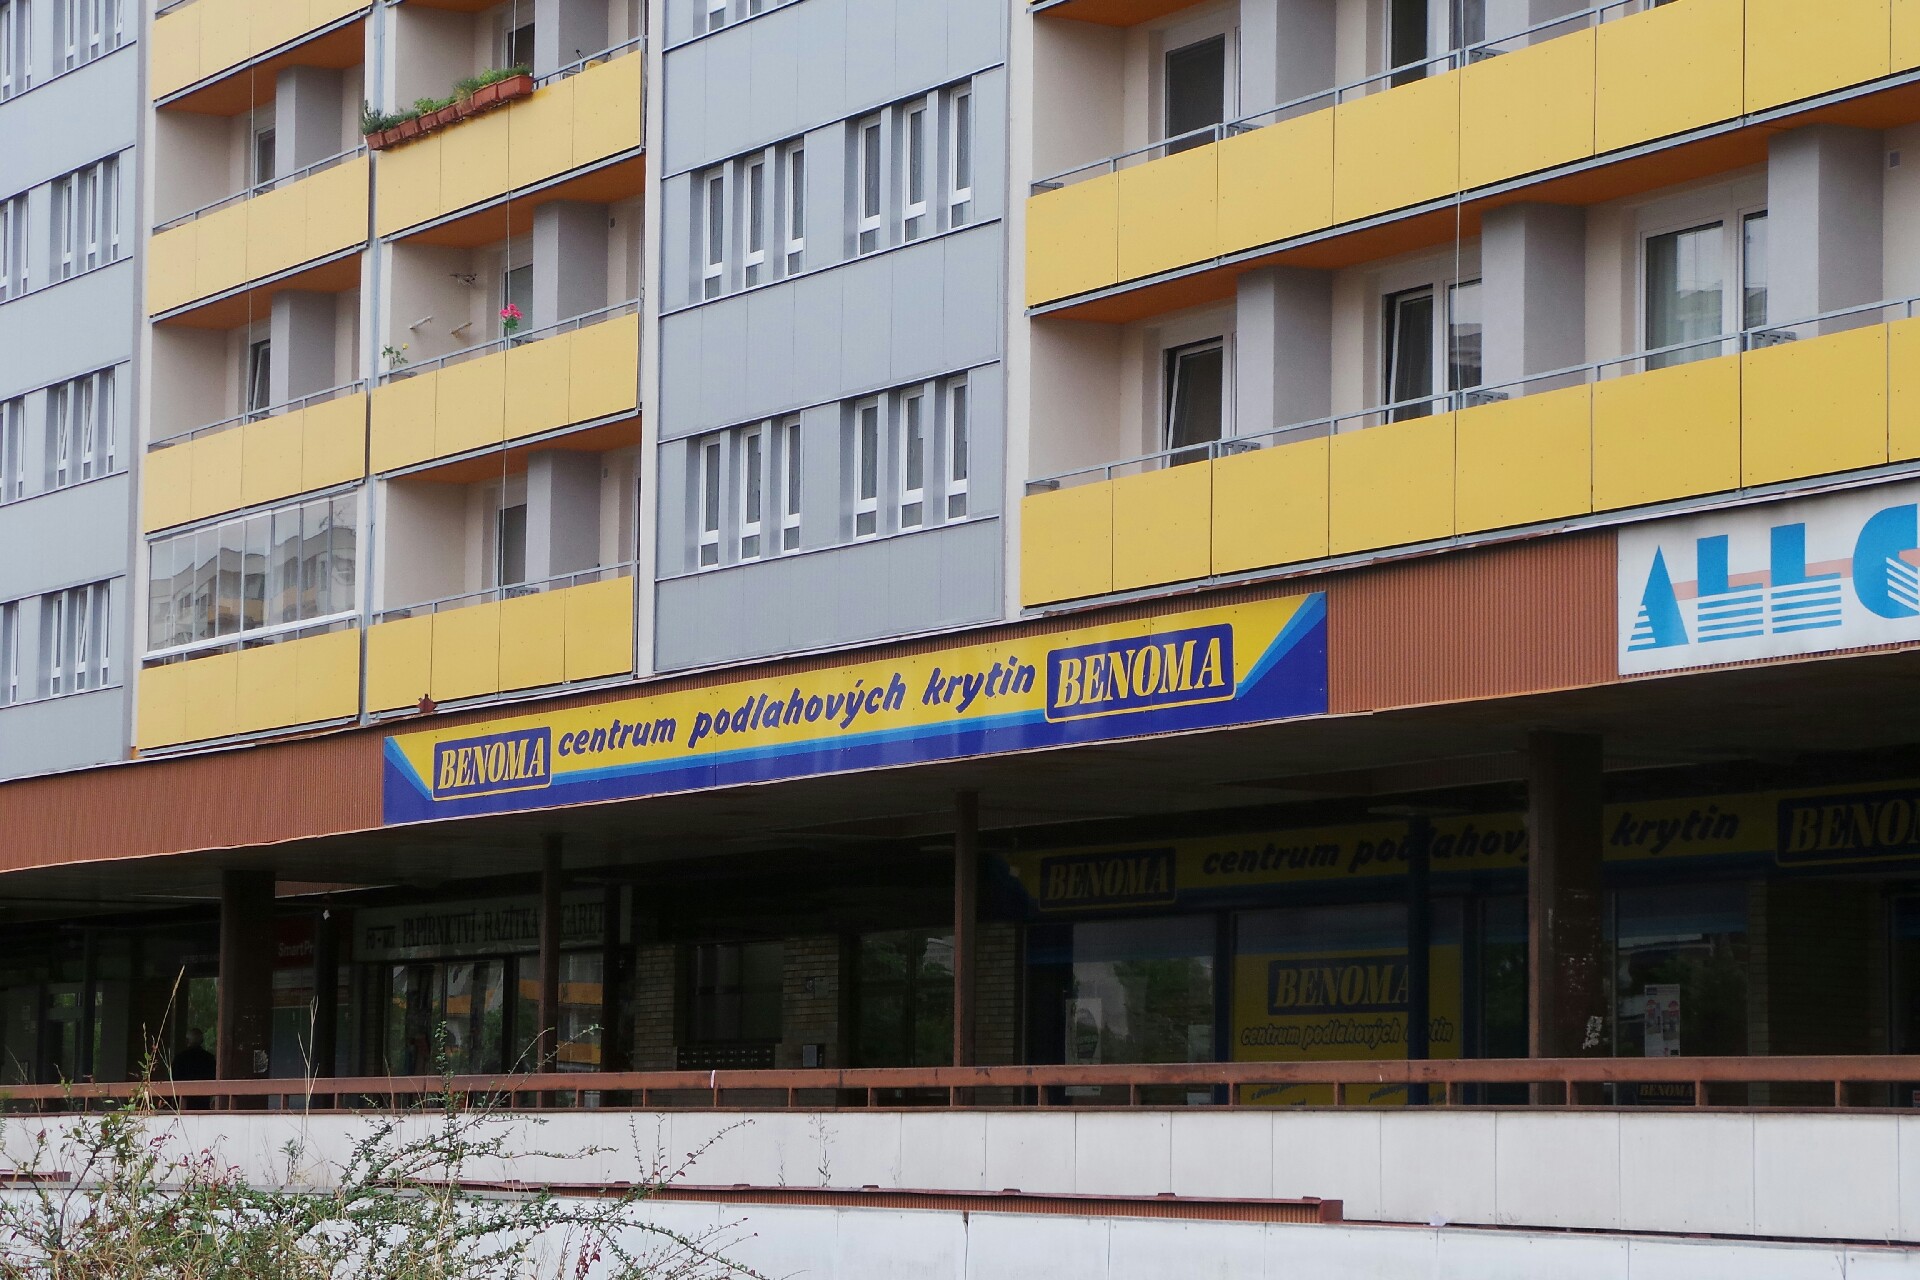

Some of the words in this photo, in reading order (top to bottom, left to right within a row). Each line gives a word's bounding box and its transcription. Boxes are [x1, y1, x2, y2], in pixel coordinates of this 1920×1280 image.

[438, 737, 546, 790] BENOMA
[557, 714, 677, 757] centrum
[687, 671, 906, 749] podlahových
[921, 655, 1036, 713] krytin
[1053, 637, 1226, 708] BENOMA
[1046, 857, 1169, 900] BENOMA
[1202, 843, 1341, 876] centrum
[1609, 805, 1740, 855] krytin
[402, 908, 476, 947] PAPÍRNICTVÍ
[484, 903, 540, 941] RAZÍTKA
[560, 902, 605, 937] GARET
[1241, 1023, 1301, 1046] centrum
[1301, 1016, 1400, 1050] podlahových
[1639, 1084, 1694, 1097] BENOMA
